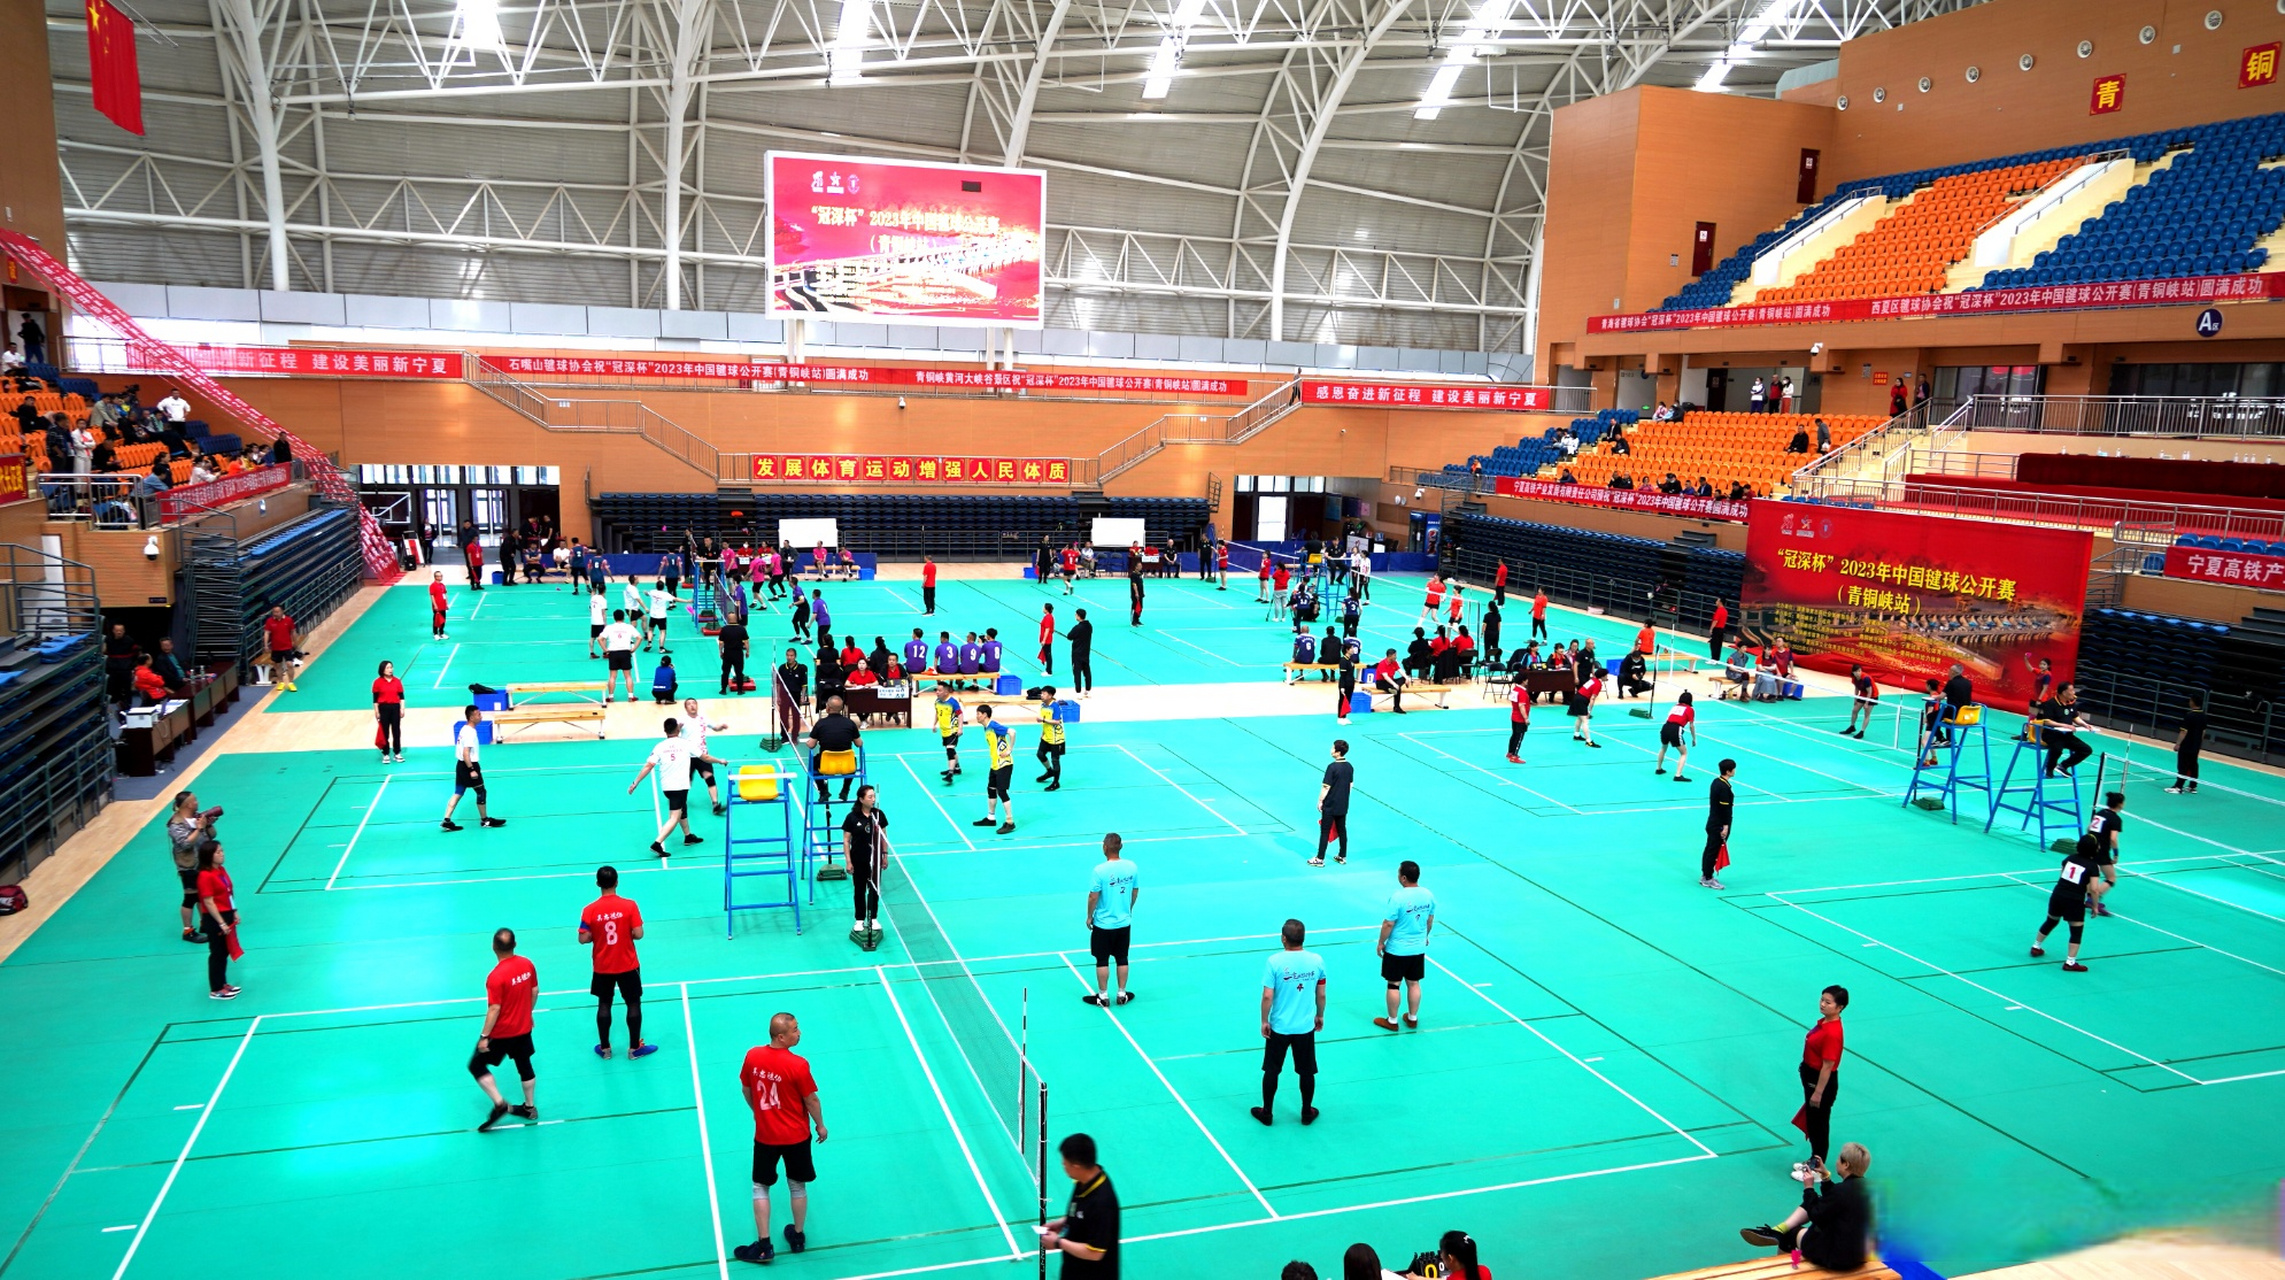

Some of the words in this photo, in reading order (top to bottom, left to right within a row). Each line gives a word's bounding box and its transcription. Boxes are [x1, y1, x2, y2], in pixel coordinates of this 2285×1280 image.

[2096, 80, 2120, 109] 青
[2246, 49, 2276, 82] 铜
[312, 353, 447, 374] 建设美丽新宁夏
[1316, 385, 1421, 403] 感恩奋进新征程
[1432, 389, 1537, 406] 建设美丽新宁夏
[757, 458, 1065, 480] 发展体育运动增强人民体质
[2187, 554, 2285, 585] 宁夏高铁产
[1840, 559, 2016, 602] 2023年中国毽球公开赛
[913, 645, 925, 658] 12
[946, 645, 954, 659] 3
[970, 648, 977, 661] 9
[994, 646, 1000, 659] 8
[670, 753, 676, 762] 5
[2091, 817, 2100, 829] 2
[2069, 866, 2076, 879] 1
[604, 921, 618, 945] 8
[756, 1080, 781, 1111] 24
[1424, 1263, 1437, 1279] 0
[1438, 1262, 1445, 1271] 0
